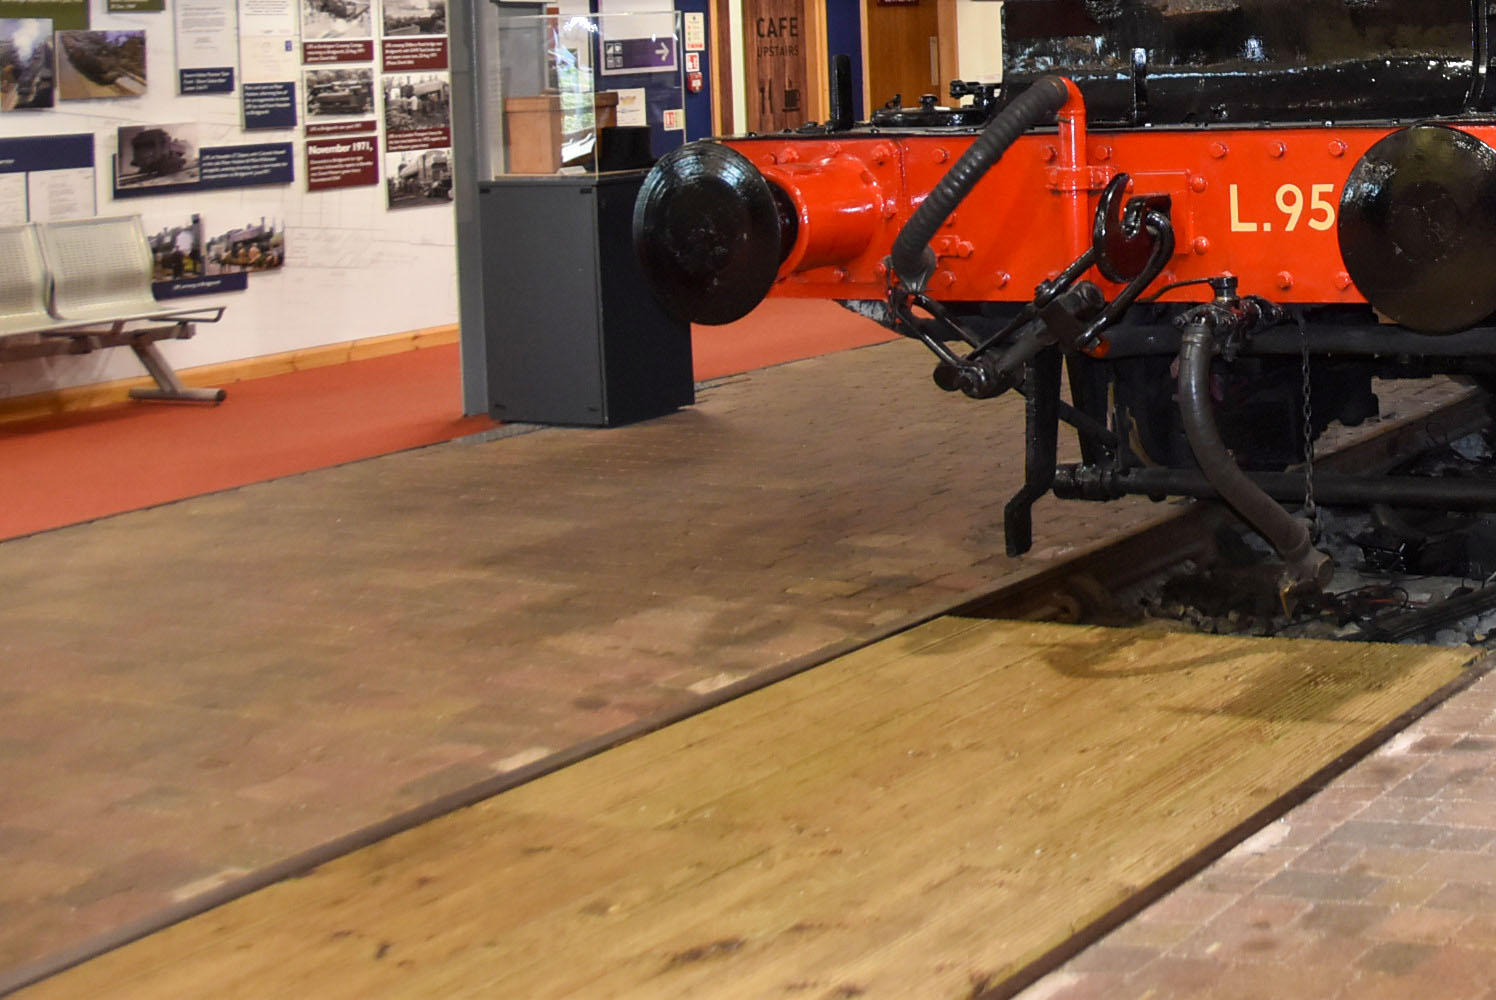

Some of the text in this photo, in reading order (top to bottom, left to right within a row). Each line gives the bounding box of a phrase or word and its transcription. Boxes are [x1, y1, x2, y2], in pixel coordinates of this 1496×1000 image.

[756, 16, 799, 38] CAFE
[756, 45, 799, 59] UPSTAIRS
[308, 143, 351, 155] November
[1229, 183, 1336, 232] L.95
